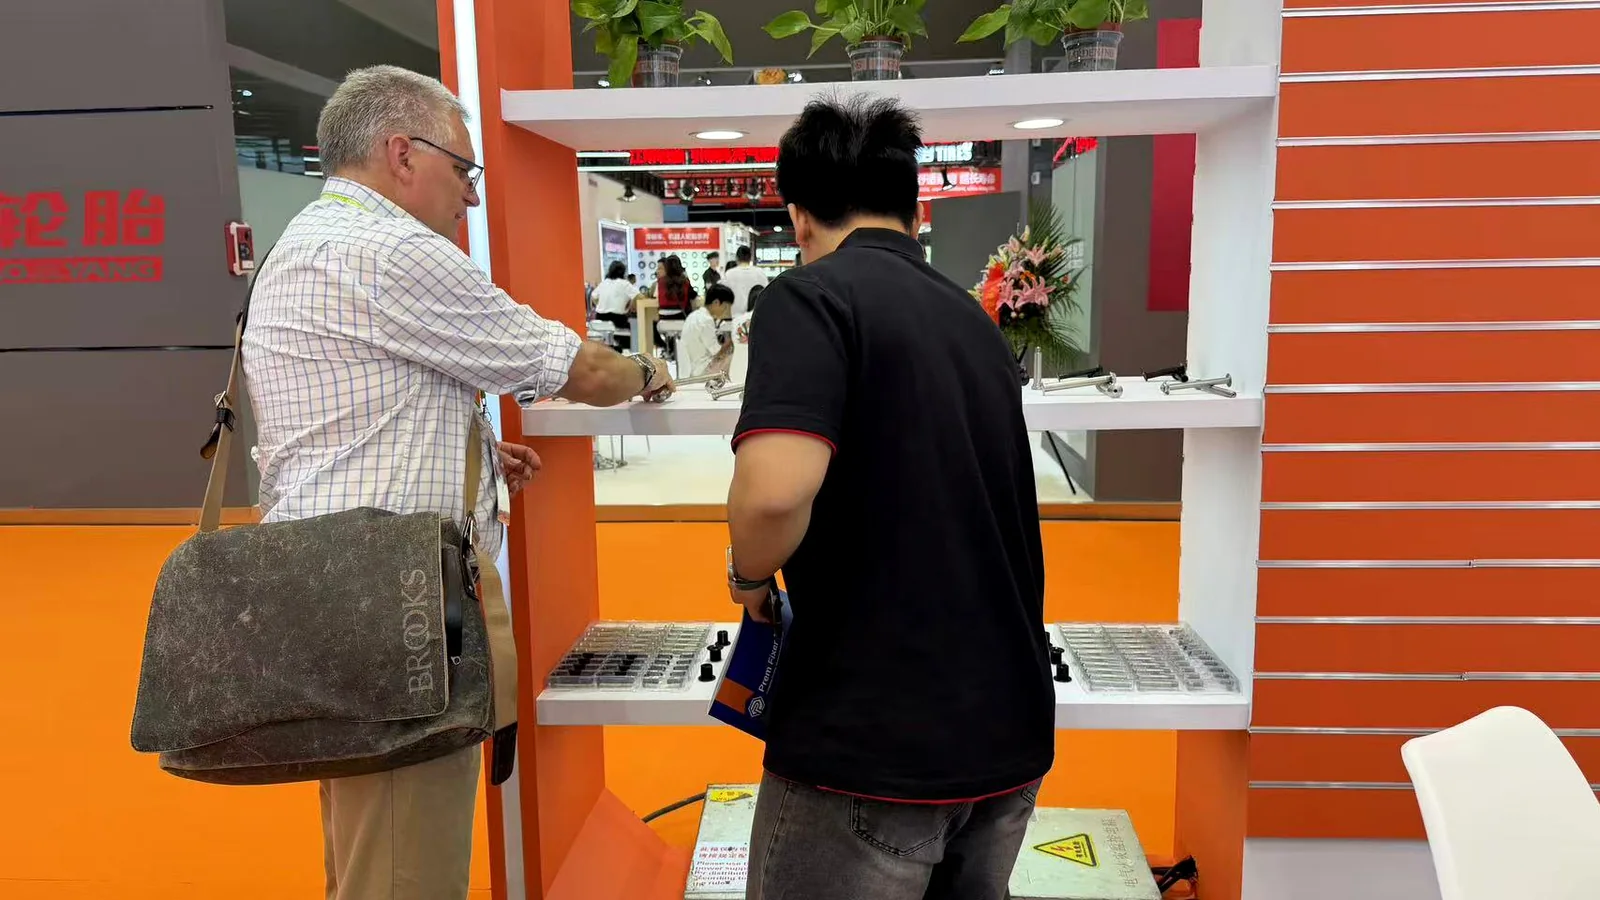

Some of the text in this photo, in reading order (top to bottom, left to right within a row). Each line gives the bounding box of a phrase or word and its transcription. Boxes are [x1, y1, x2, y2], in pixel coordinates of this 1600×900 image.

[66, 261, 156, 280] YANG
[400, 569, 433, 695] BROOKS
[758, 666, 773, 692] Prem
[767, 640, 780, 666] Fixer
